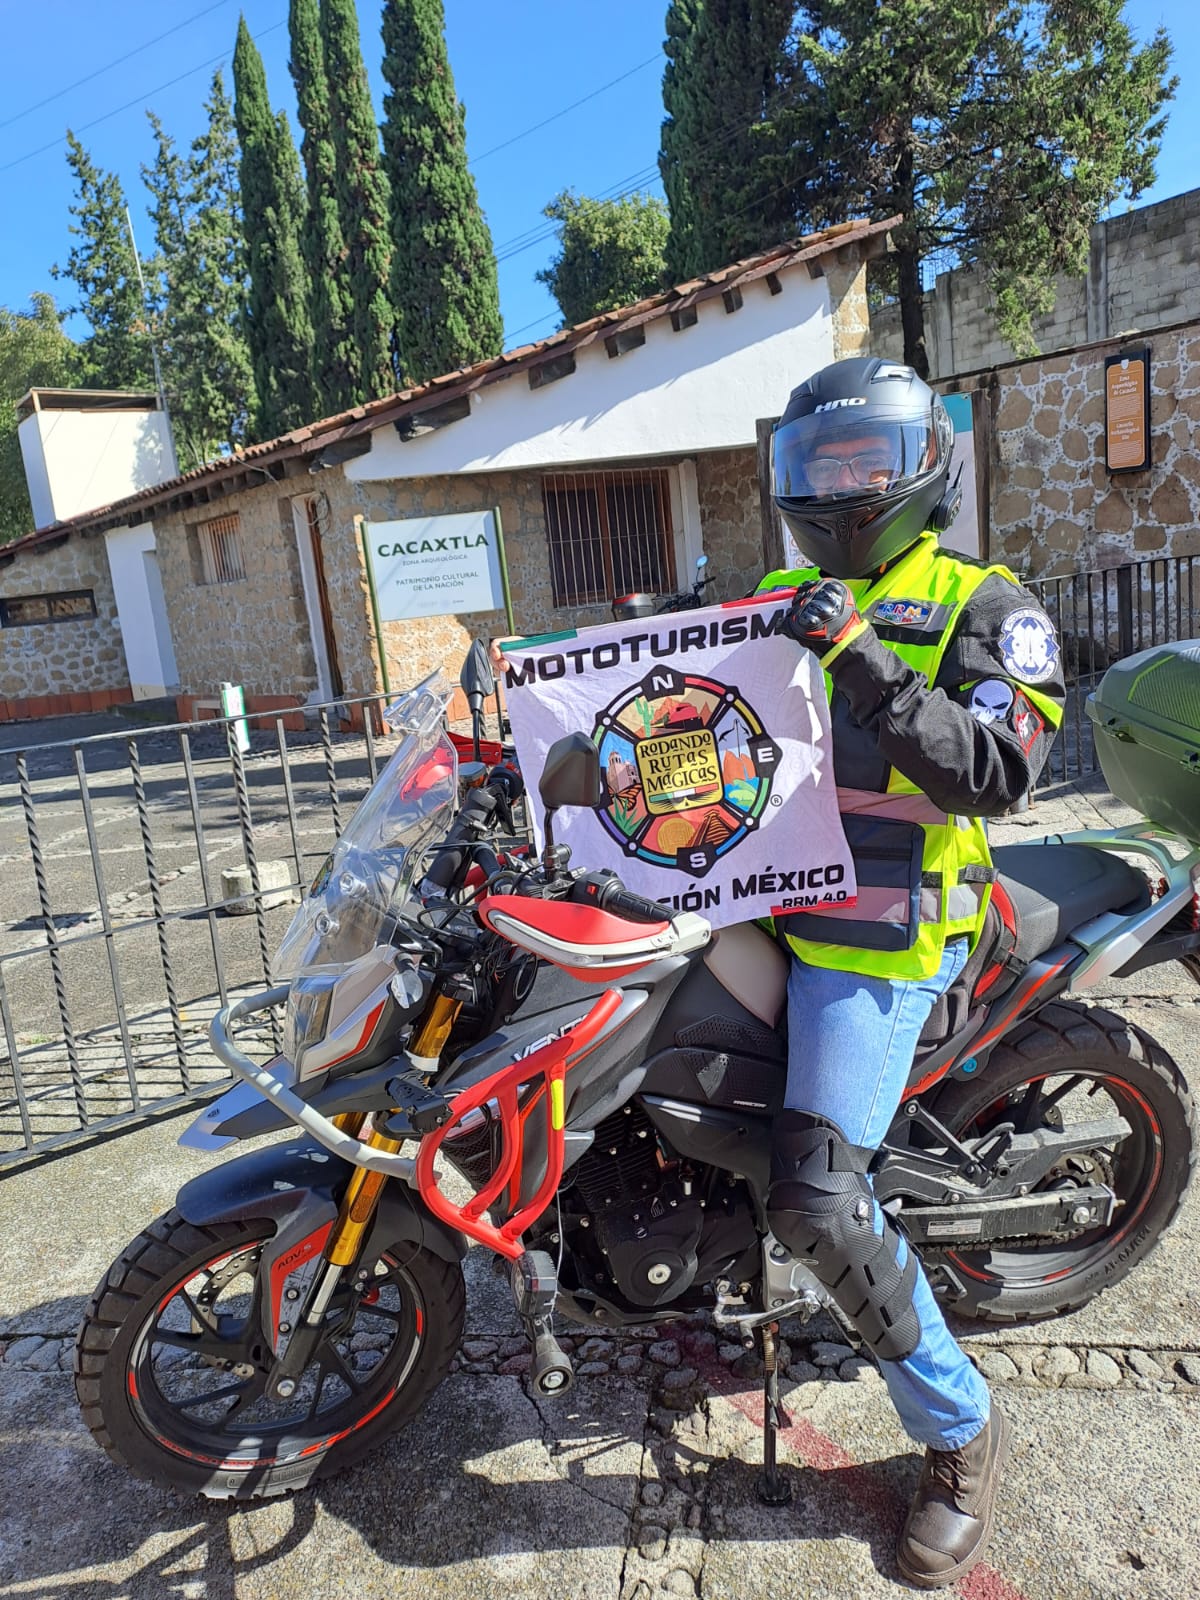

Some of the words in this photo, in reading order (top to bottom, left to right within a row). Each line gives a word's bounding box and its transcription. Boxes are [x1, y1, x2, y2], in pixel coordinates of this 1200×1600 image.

[814, 398, 866, 414] HRO
[377, 534, 489, 557] CACAXTLA
[396, 576, 440, 586] PATRIMONIO
[442, 571, 479, 581] CULTURAL
[424, 583, 434, 591] LA
[435, 580, 464, 589] NACIÓN
[881, 603, 922, 618] RRM
[505, 608, 792, 689] MOTOTURISM
[652, 674, 674, 690] N
[757, 747, 774, 763] E
[689, 853, 708, 868] S
[732, 864, 845, 900] MÉXICO
[782, 894, 818, 909] RRM
[823, 890, 847, 902] 4.0
[513, 1013, 589, 1061] VENT
